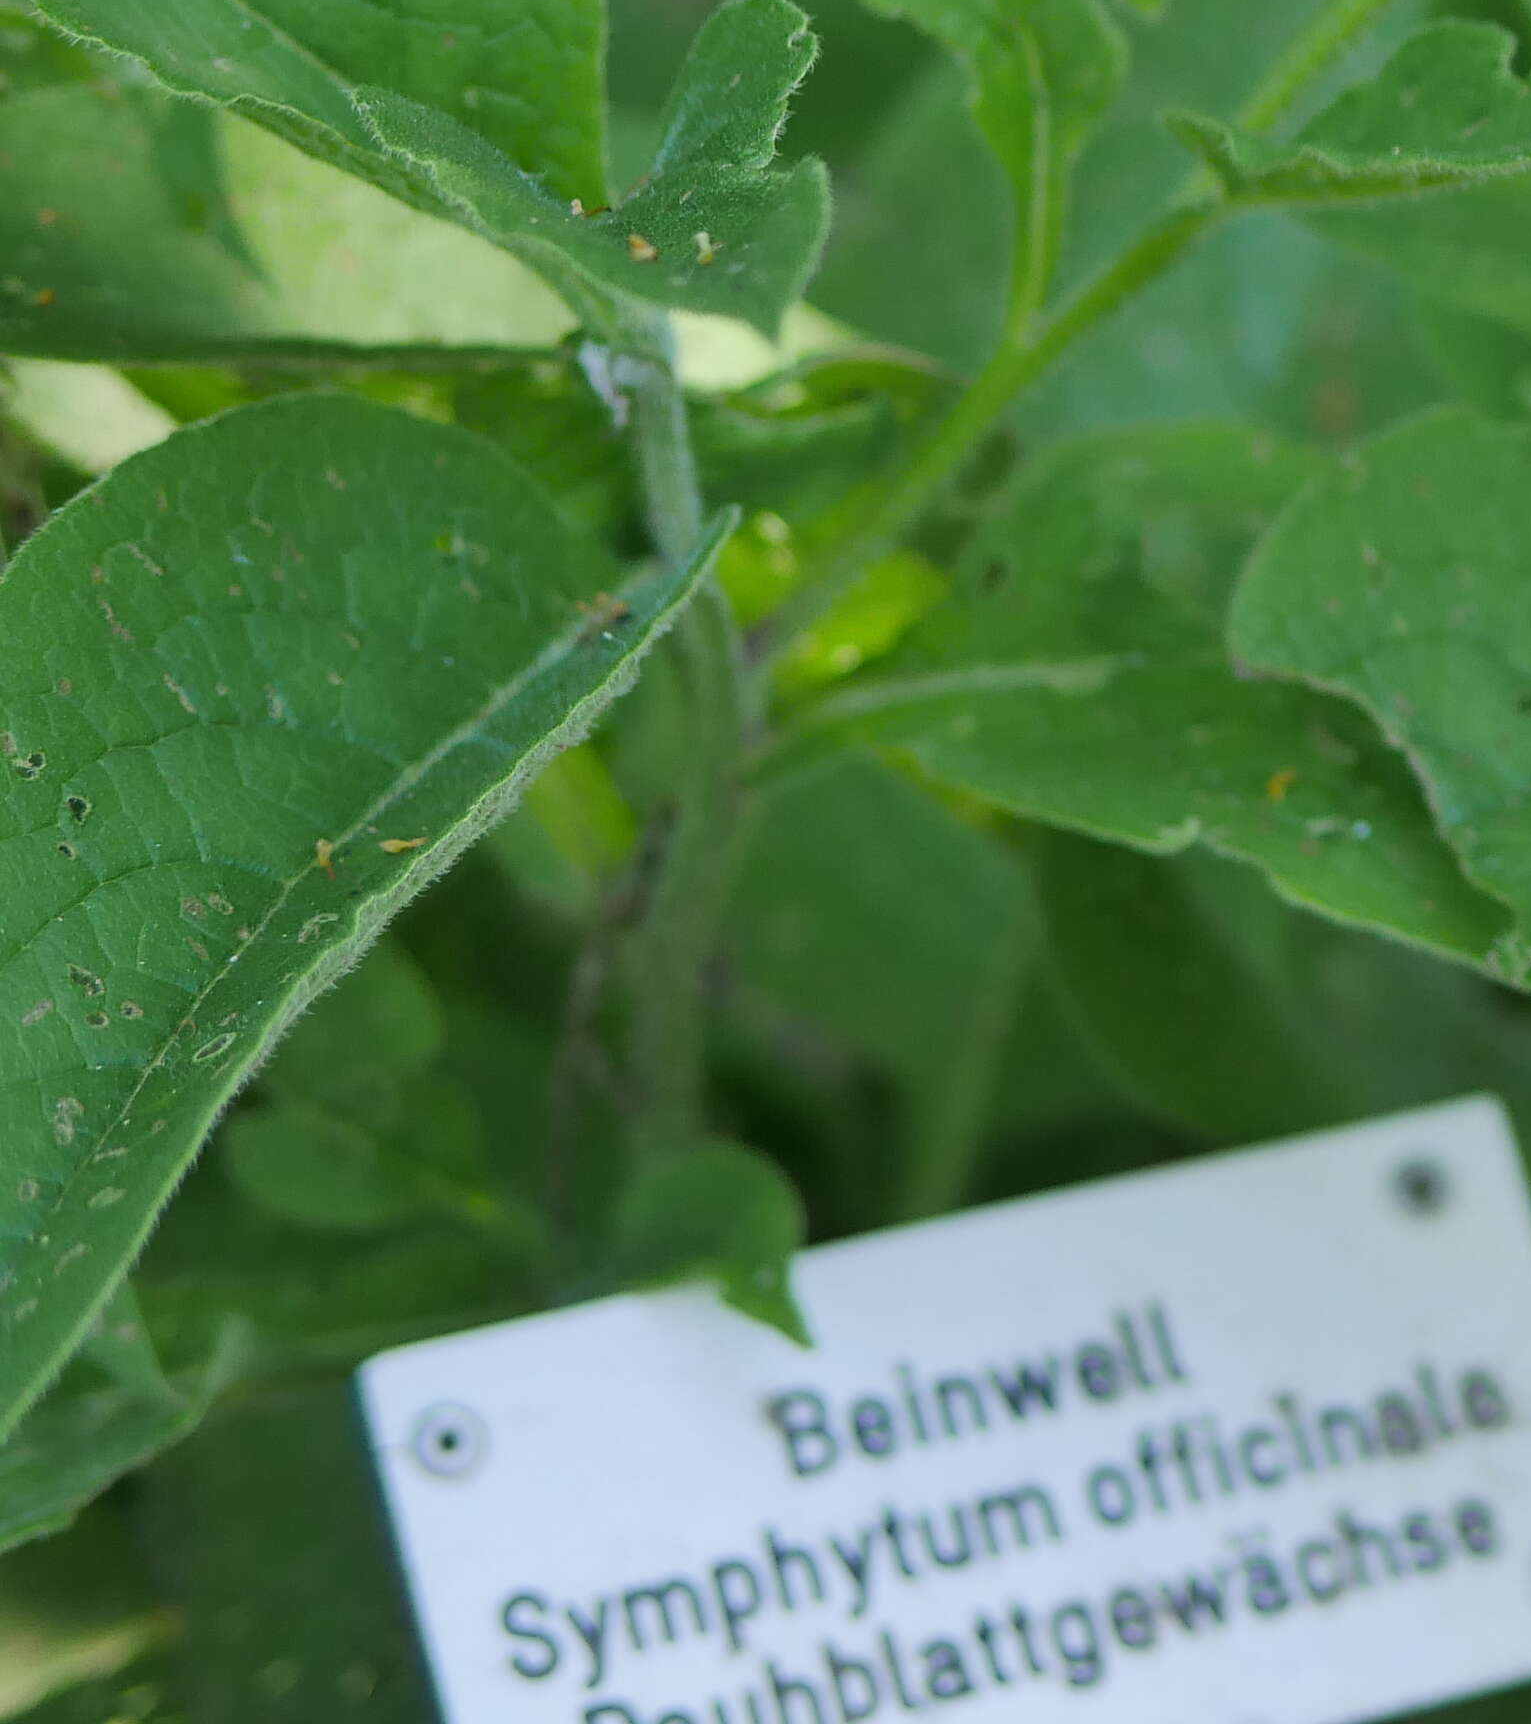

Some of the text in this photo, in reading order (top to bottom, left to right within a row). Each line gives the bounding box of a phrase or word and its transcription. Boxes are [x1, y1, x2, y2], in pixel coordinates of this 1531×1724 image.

[768, 1304, 1186, 1478] Beinwell
[500, 1362, 1508, 1690] Symphytum officinale
